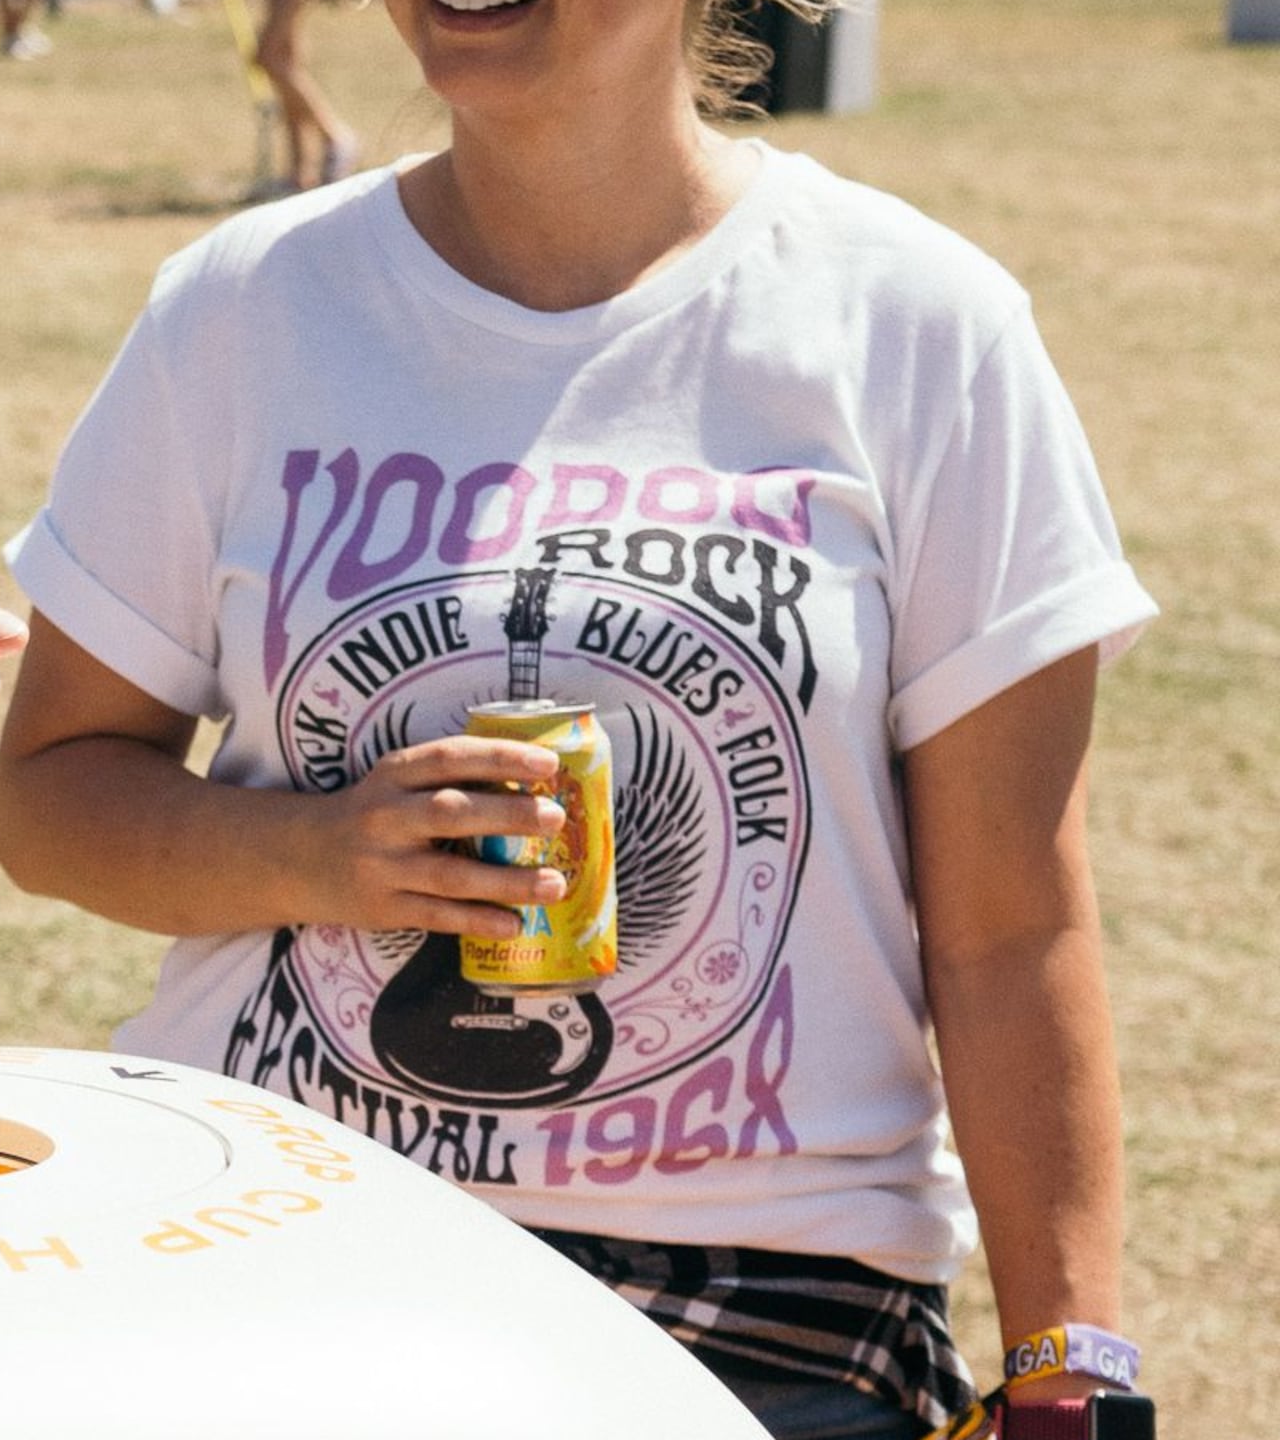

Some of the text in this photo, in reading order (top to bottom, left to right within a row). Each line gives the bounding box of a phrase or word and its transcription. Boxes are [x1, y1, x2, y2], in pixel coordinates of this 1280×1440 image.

[264, 447, 818, 695] VOODOO
[536, 529, 818, 717] ROCK
[295, 595, 788, 847] OCK INDIE BLUES FOLK
[205, 1100, 356, 1182] DROP
[536, 963, 798, 1187] 1968
[143, 1190, 322, 1253] CUP
[1015, 1336, 1058, 1376] GA
[1096, 1347, 1132, 1386] GA
